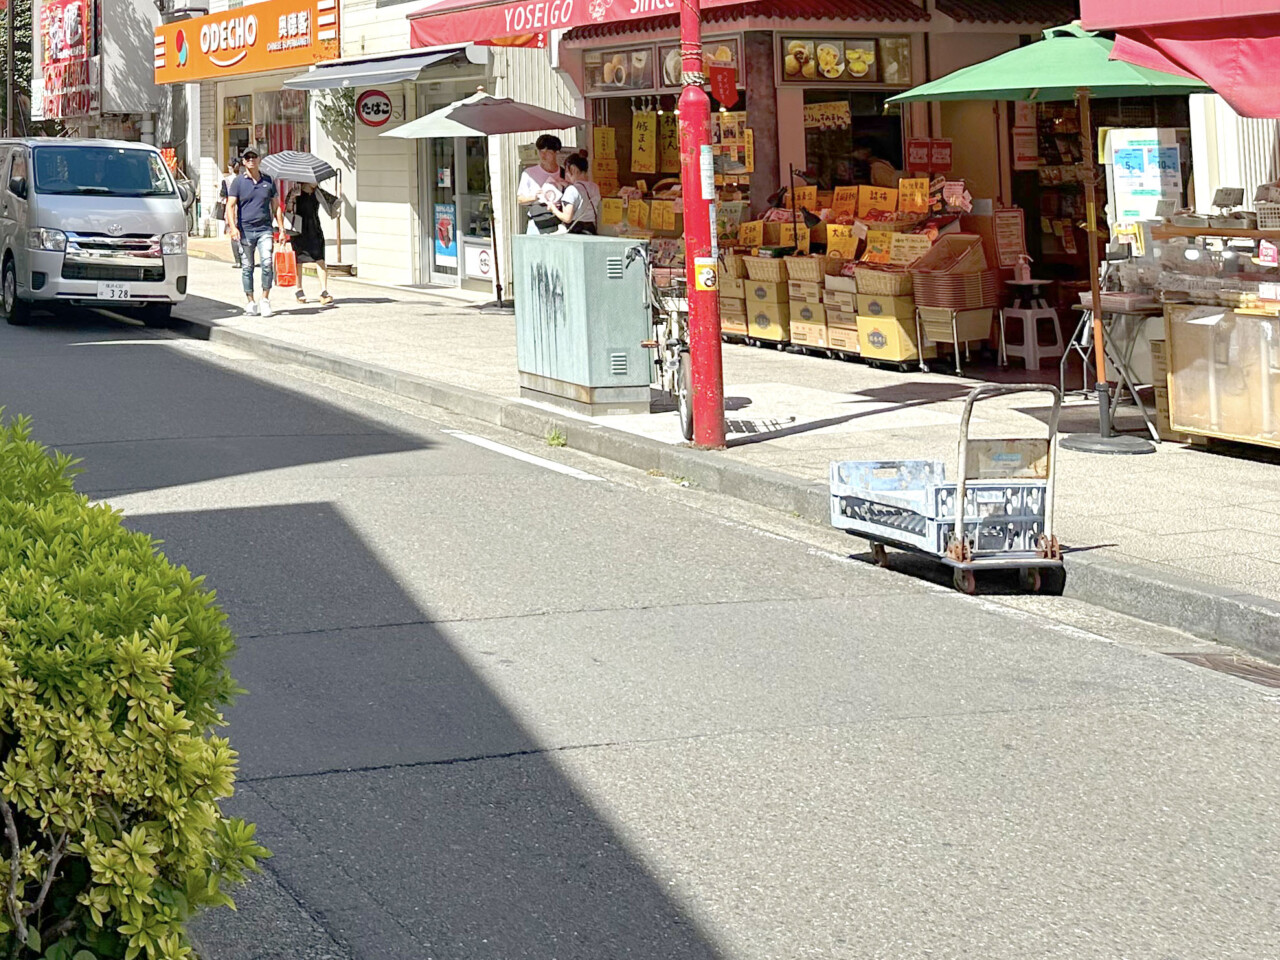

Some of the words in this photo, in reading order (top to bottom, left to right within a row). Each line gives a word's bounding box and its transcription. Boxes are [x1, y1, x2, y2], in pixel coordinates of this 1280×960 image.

[200, 14, 257, 53] ODECHO
[361, 102, 390, 115] たばこ
